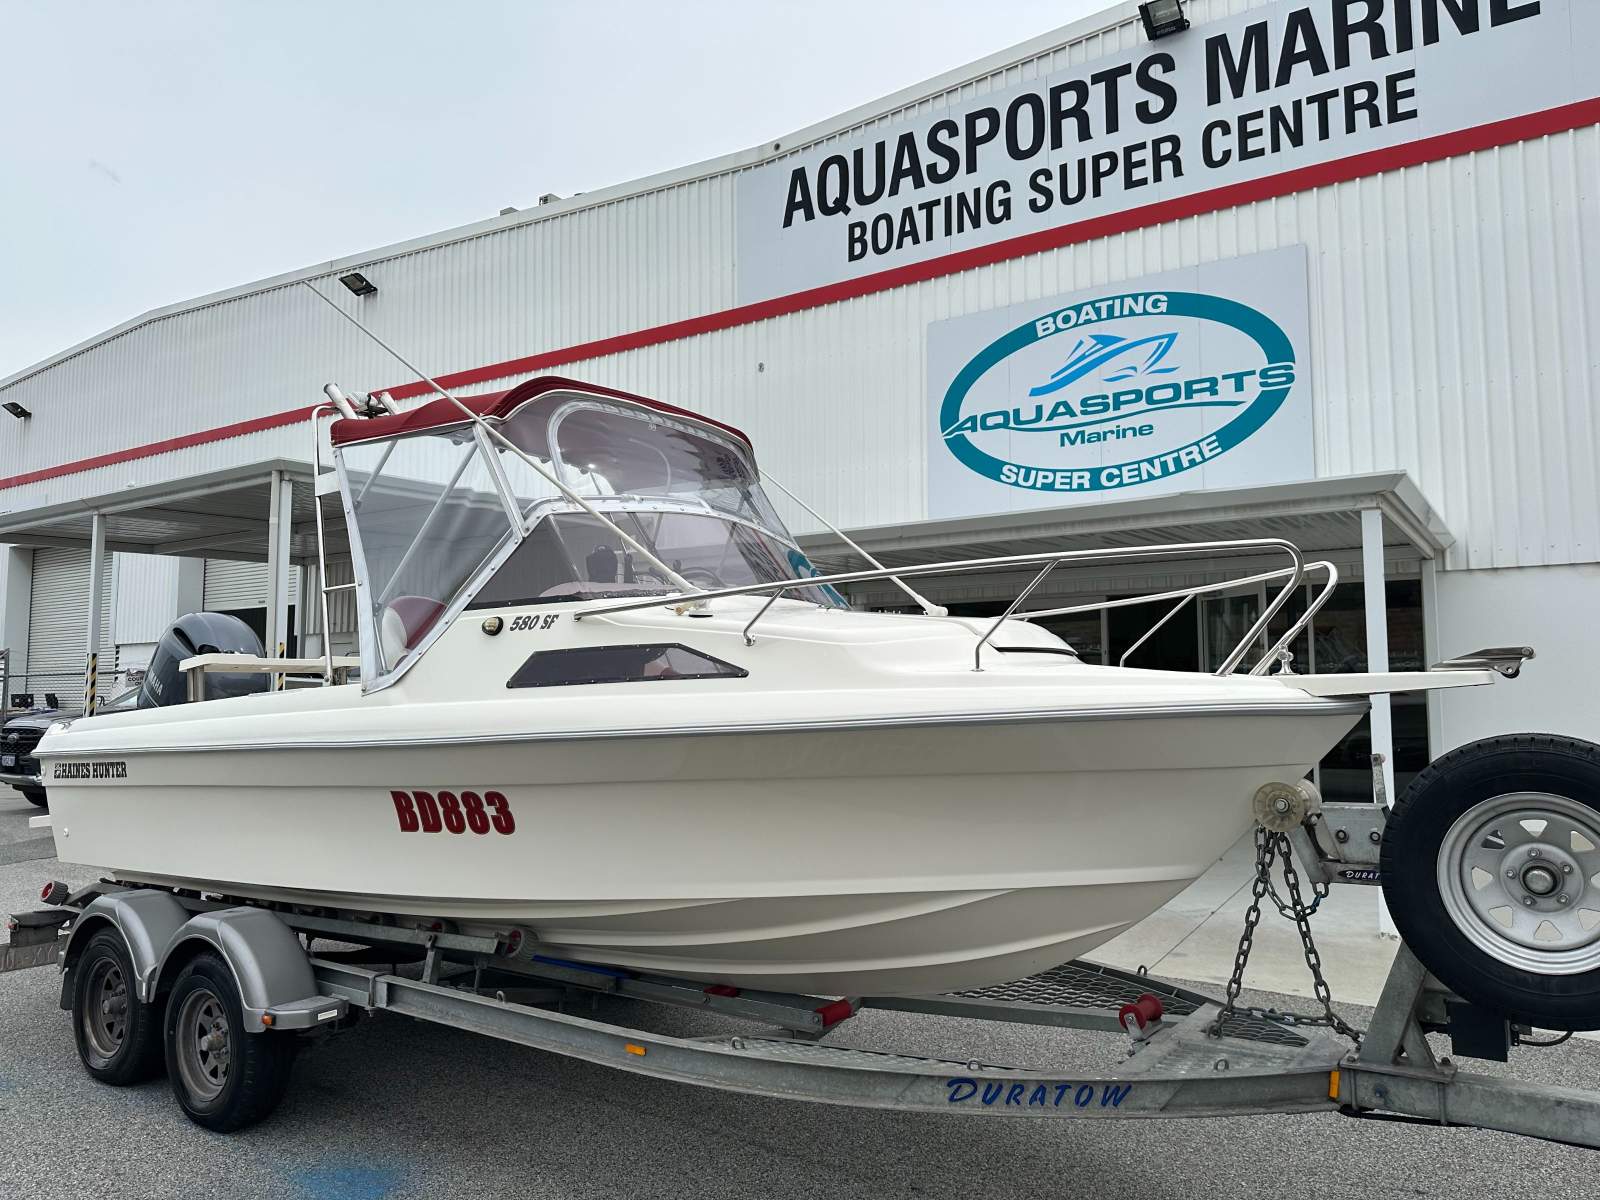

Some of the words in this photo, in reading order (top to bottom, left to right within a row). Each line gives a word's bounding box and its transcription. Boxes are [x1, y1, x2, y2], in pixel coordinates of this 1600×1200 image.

[783, 52, 1177, 229] AQUASPORTS
[1205, 0, 1541, 107] MARIN
[847, 180, 1012, 262] BOATING
[1028, 134, 1184, 213] SUPER
[1201, 69, 1418, 168] CENTRE
[1035, 294, 1168, 338] BOATING
[943, 364, 1296, 438] AQUASPORTS
[1059, 423, 1154, 447] Marine
[1000, 464, 1091, 489] SUPER
[1100, 435, 1223, 487] CENTRE
[509, 614, 540, 632] 580
[540, 614, 560, 630] SF
[61, 762, 90, 779] HAINES
[92, 761, 128, 779] HUNTER
[389, 790, 516, 835] BD883
[946, 1077, 1132, 1108] DURATOW
